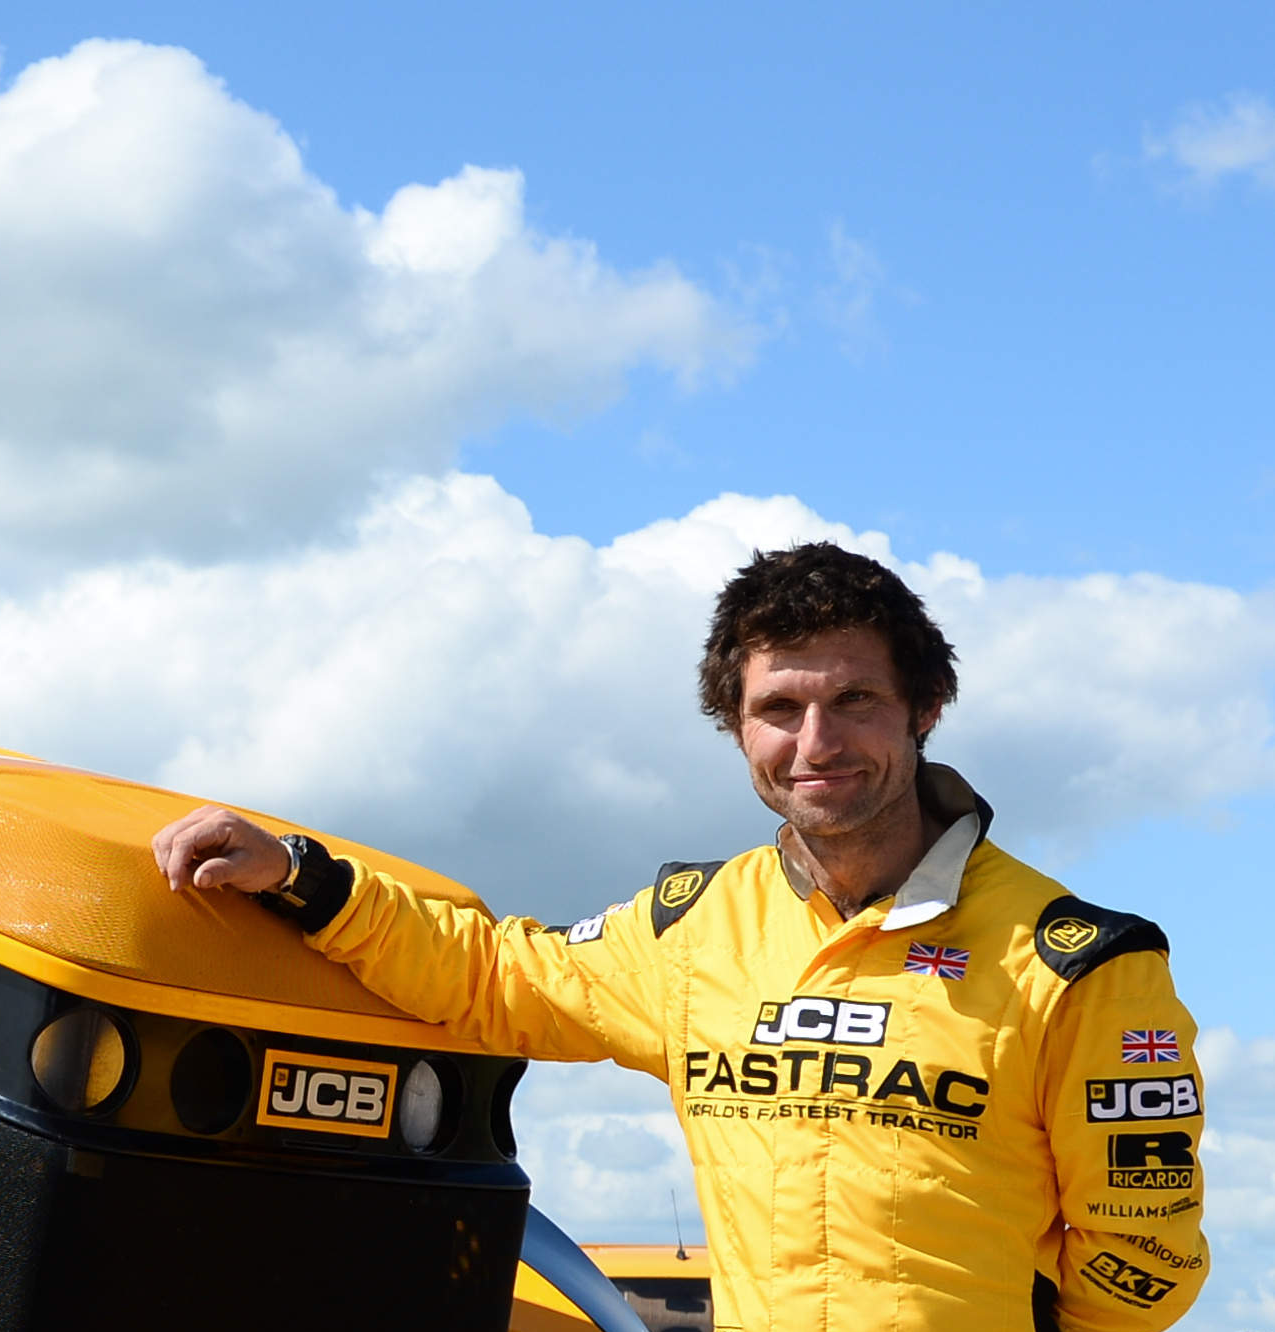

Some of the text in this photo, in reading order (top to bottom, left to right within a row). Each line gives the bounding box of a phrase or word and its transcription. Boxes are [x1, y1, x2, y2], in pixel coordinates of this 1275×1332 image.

[755, 998, 886, 1044] JCB
[272, 1069, 385, 1121] JCB
[685, 1050, 990, 1117] FASTRAC
[1090, 1078, 1199, 1119] JCB
[866, 1110, 978, 1140] TRACTOR
[1112, 1171, 1191, 1187] RICARDO
[1087, 1203, 1168, 1218] WILLIAMS
[1090, 1253, 1175, 1300] BKT
